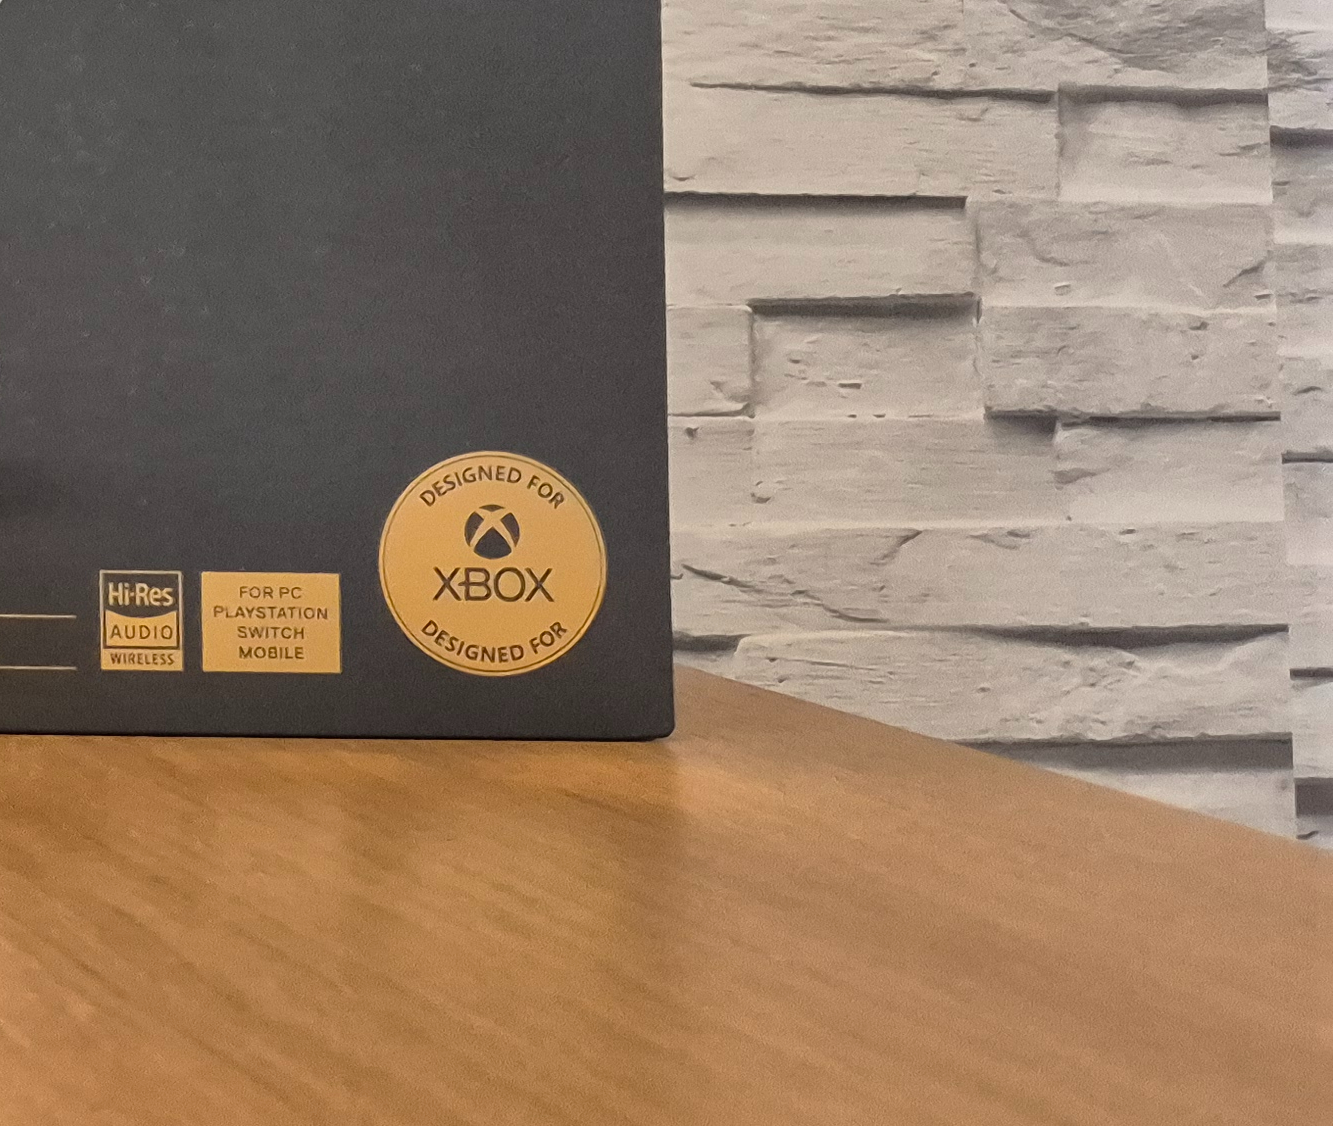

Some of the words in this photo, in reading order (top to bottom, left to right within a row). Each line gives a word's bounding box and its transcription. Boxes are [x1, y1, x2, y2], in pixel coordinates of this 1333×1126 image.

[419, 464, 522, 508] DESIGNED
[526, 474, 566, 510] FOR
[239, 585, 273, 599] FOR
[279, 585, 303, 600] PC
[432, 566, 555, 603] XBOX
[107, 581, 175, 607] Hi-Res
[213, 605, 328, 621] PLAYSTATION
[109, 624, 174, 640] AUDIO
[237, 625, 305, 640] SWITCH
[420, 619, 525, 664] DESIGNED
[528, 621, 568, 655] FOR
[109, 652, 175, 666] WIRELESS
[238, 645, 305, 661] MOBILE
